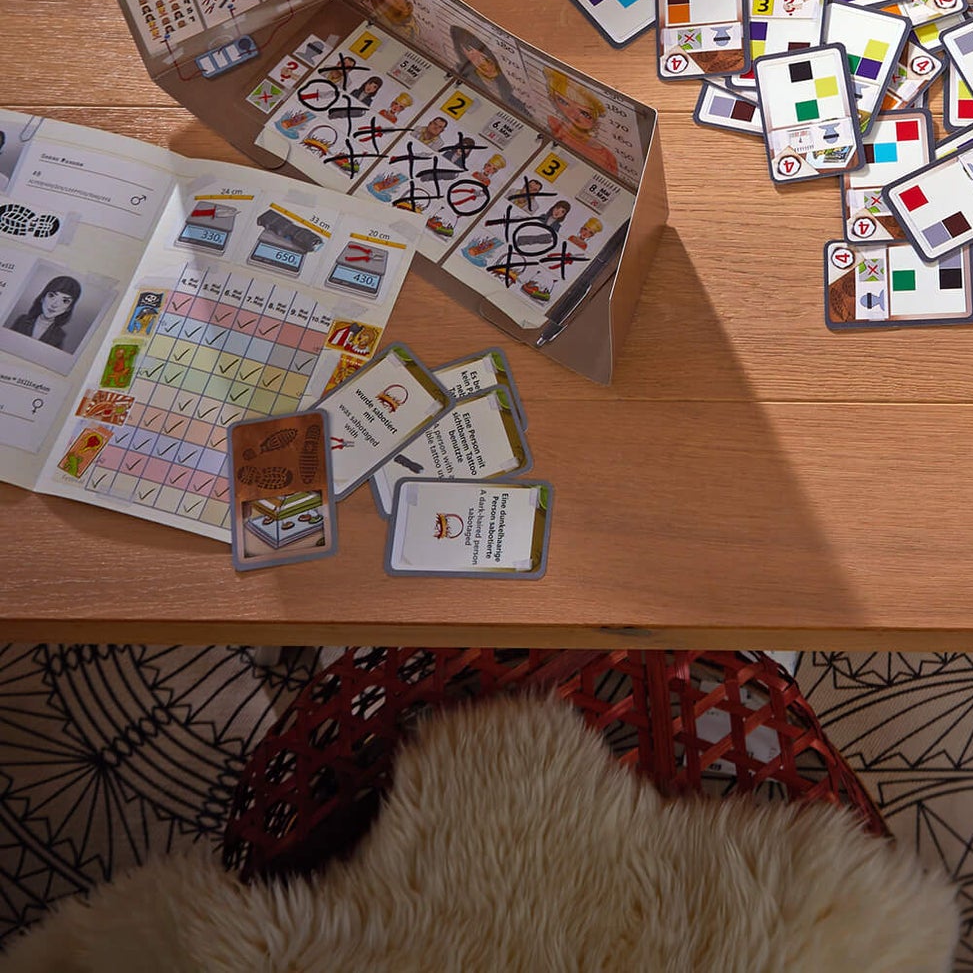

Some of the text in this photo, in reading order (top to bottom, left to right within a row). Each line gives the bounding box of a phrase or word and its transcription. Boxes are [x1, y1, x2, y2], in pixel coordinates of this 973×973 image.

[359, 39, 374, 53] 1
[916, 60, 929, 72] 4
[448, 98, 466, 115] 2
[542, 160, 561, 176] 3
[318, 221, 331, 230] cm
[859, 222, 870, 235] 4
[461, 371, 470, 386] kein
[470, 371, 477, 380] Es
[355, 388, 398, 435] wurde sabotiert
[362, 410, 375, 423] mit
[339, 404, 380, 448] was sabotaged
[344, 424, 359, 439] with
[434, 429, 453, 473] person with
[448, 431, 463, 463] benutzte
[452, 412, 469, 449] sichtbarem
[466, 449, 477, 475] Tattoo
[462, 412, 486, 468] Eine Person mit
[429, 445, 441, 470] tattoo
[465, 508, 475, 546] sabotaged
[474, 497, 486, 539] dark-haired
[485, 496, 499, 559] Person sabotierte
[494, 493, 509, 562] Eine dunkelhaarige
[472, 540, 481, 565] person
